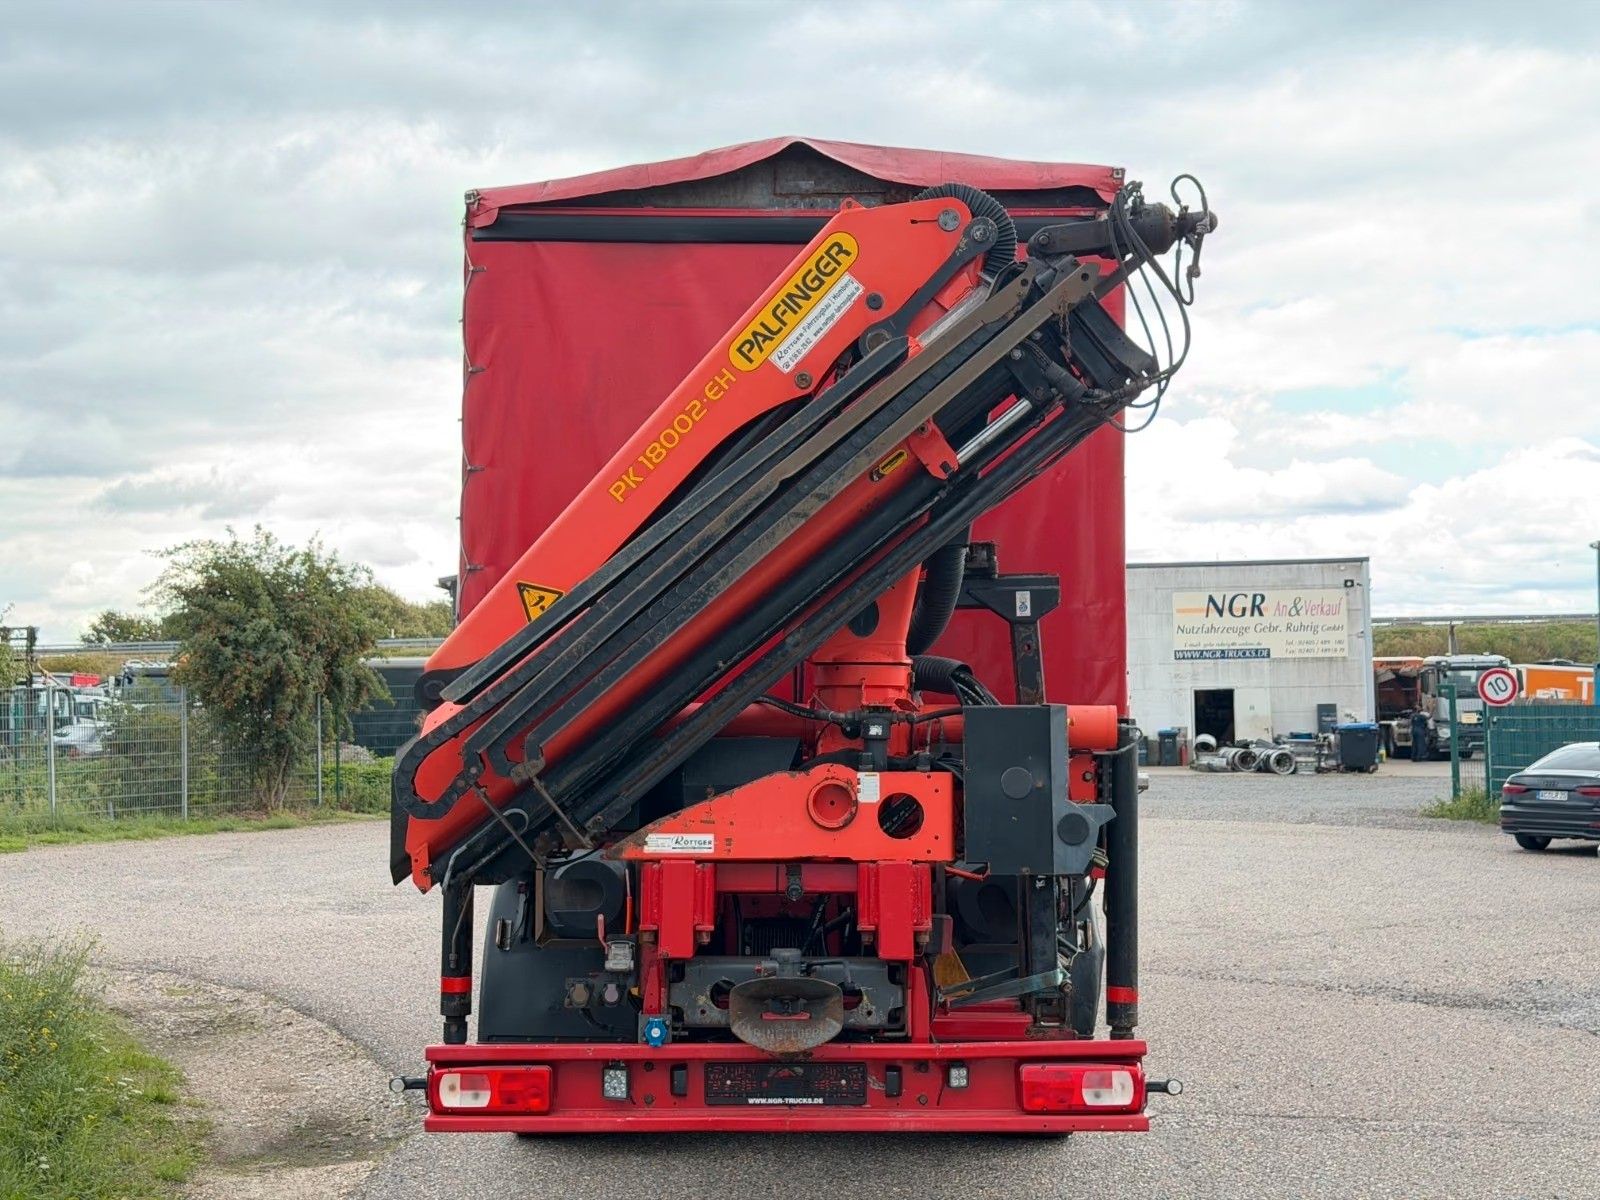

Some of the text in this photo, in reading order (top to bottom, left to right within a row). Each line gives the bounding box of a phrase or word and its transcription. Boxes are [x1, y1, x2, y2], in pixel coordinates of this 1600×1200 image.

[736, 241, 852, 364] PALFINGER
[608, 466, 644, 503] PK
[1205, 593, 1266, 618] NGR
[1176, 623, 1250, 637] Nutzfahrzeuge
[1254, 622, 1282, 634] Gebr.
[1286, 621, 1319, 635] Ruhrig
[1488, 677, 1508, 695] 10
